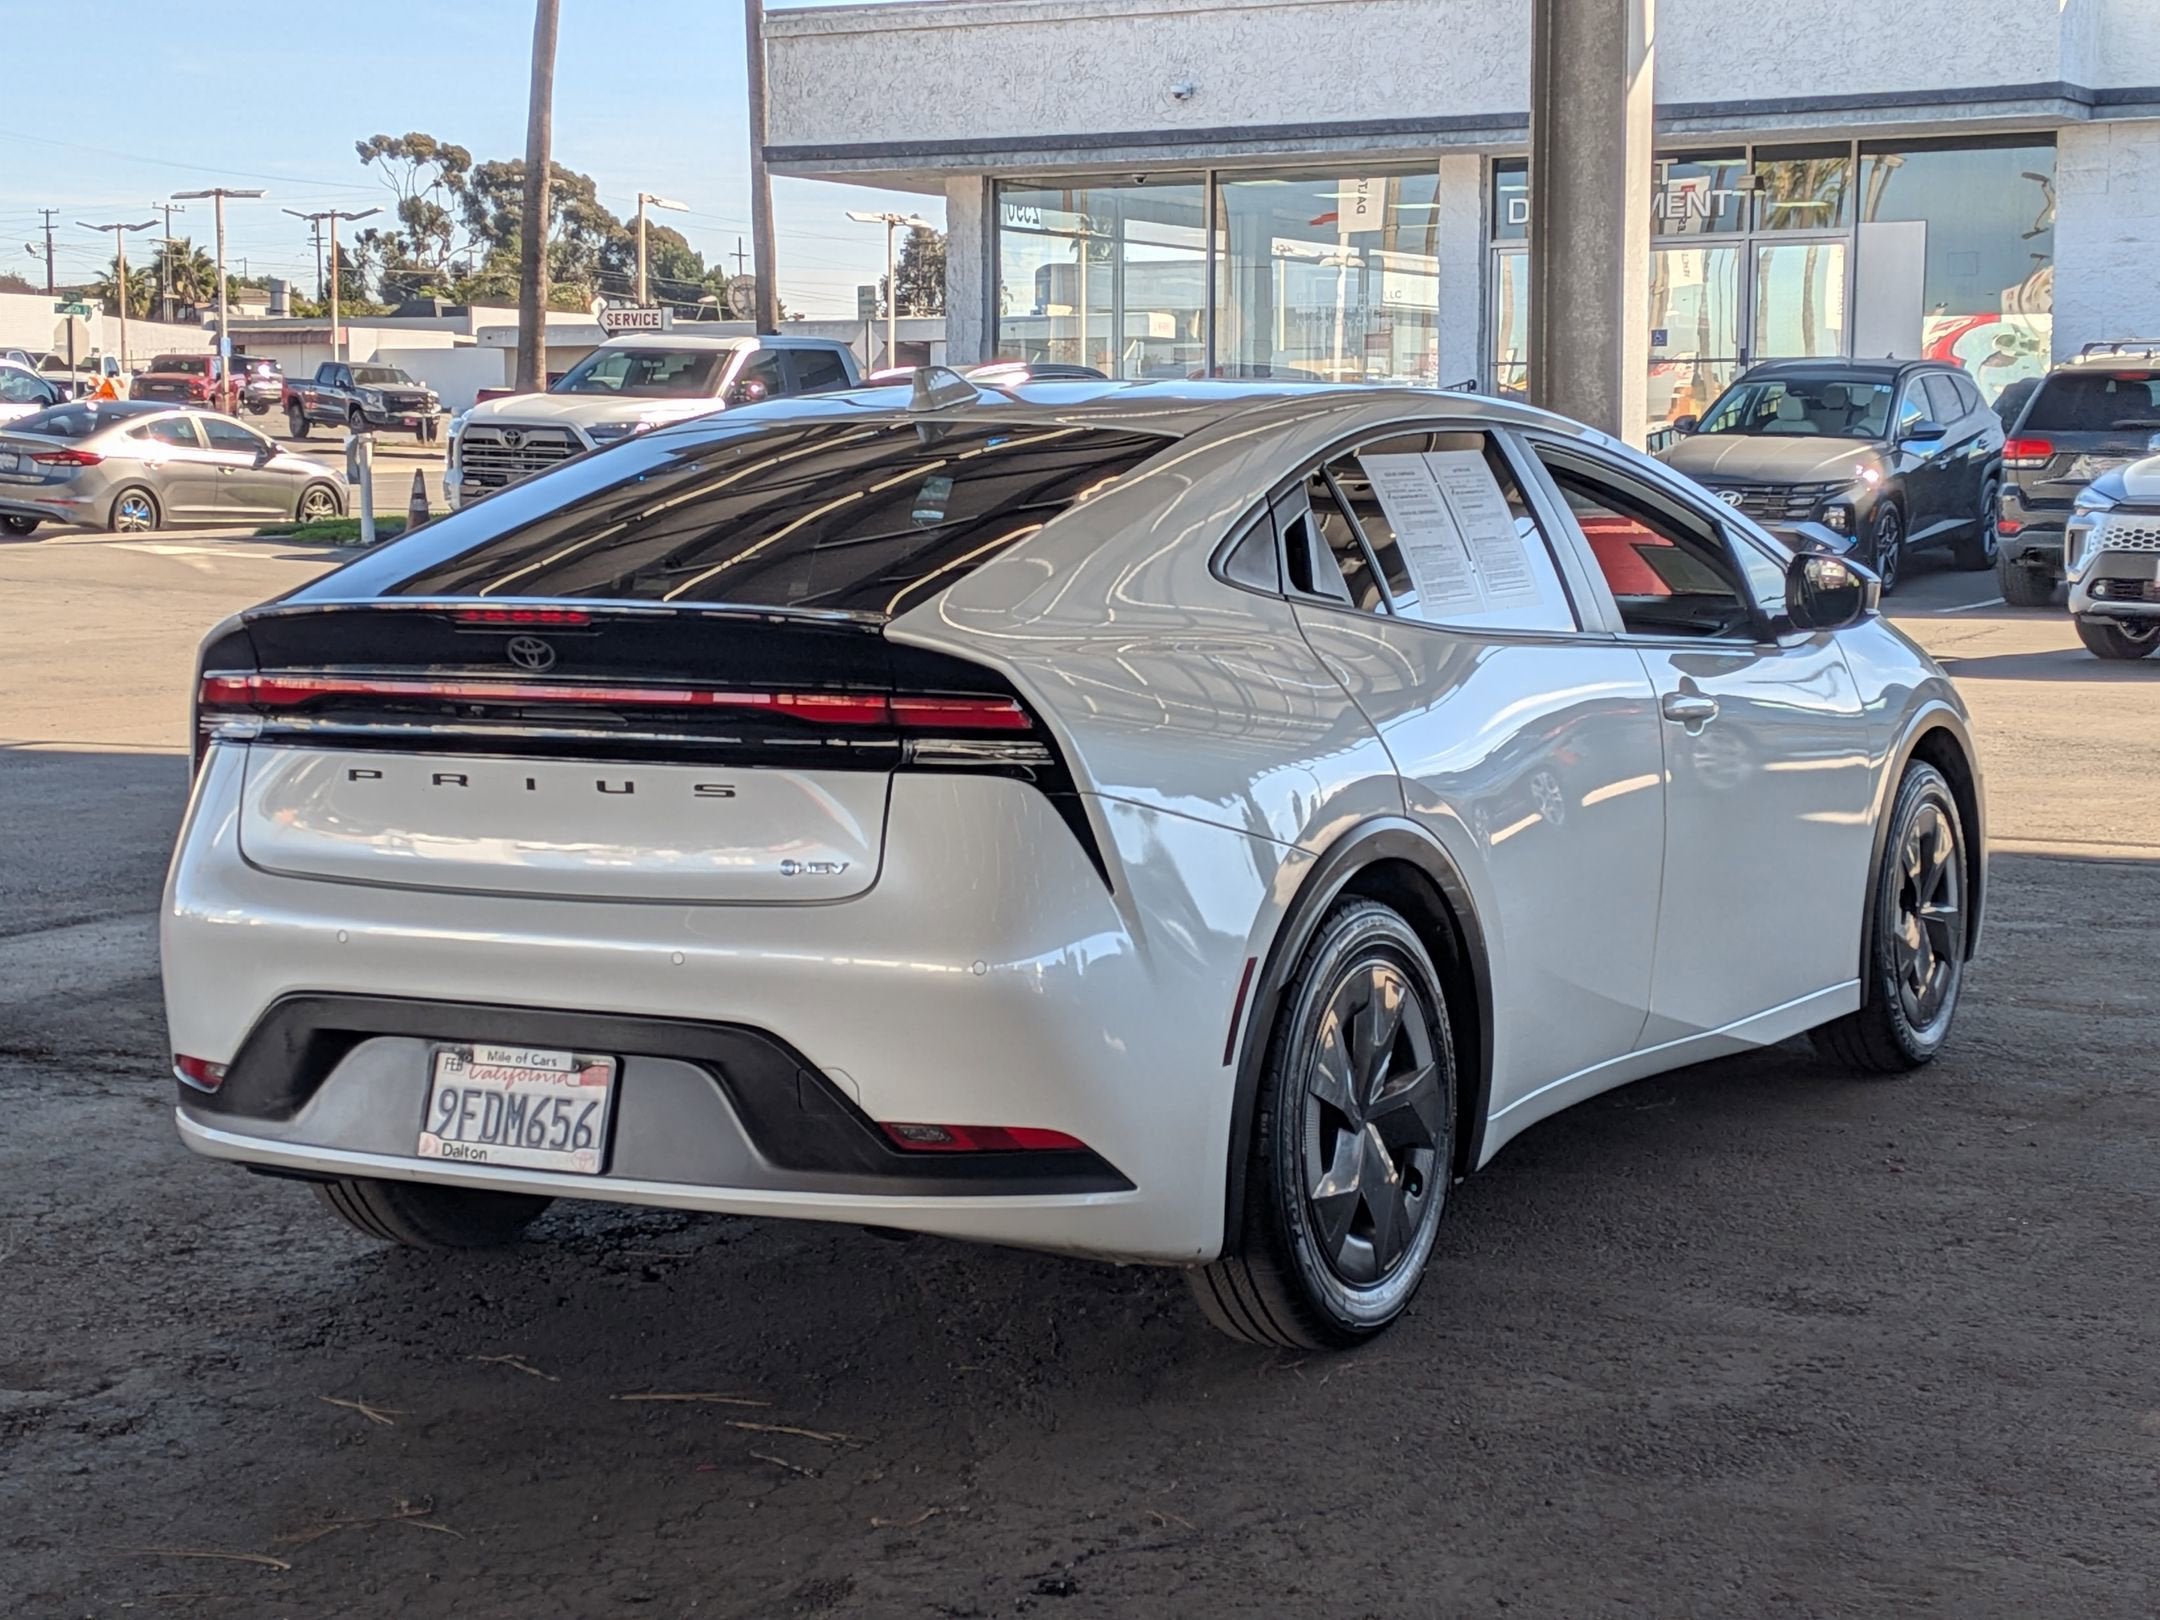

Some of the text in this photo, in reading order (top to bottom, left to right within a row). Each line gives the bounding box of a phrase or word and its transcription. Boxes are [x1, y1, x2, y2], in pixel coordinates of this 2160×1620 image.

[606, 313, 659, 327] SERVICE
[348, 768, 736, 799] PRIUS
[444, 1056, 463, 1072] FEB
[487, 1050, 557, 1067] Mile of Cars
[436, 1088, 599, 1150] 9FDM656
[441, 1142, 488, 1161] Dalton
